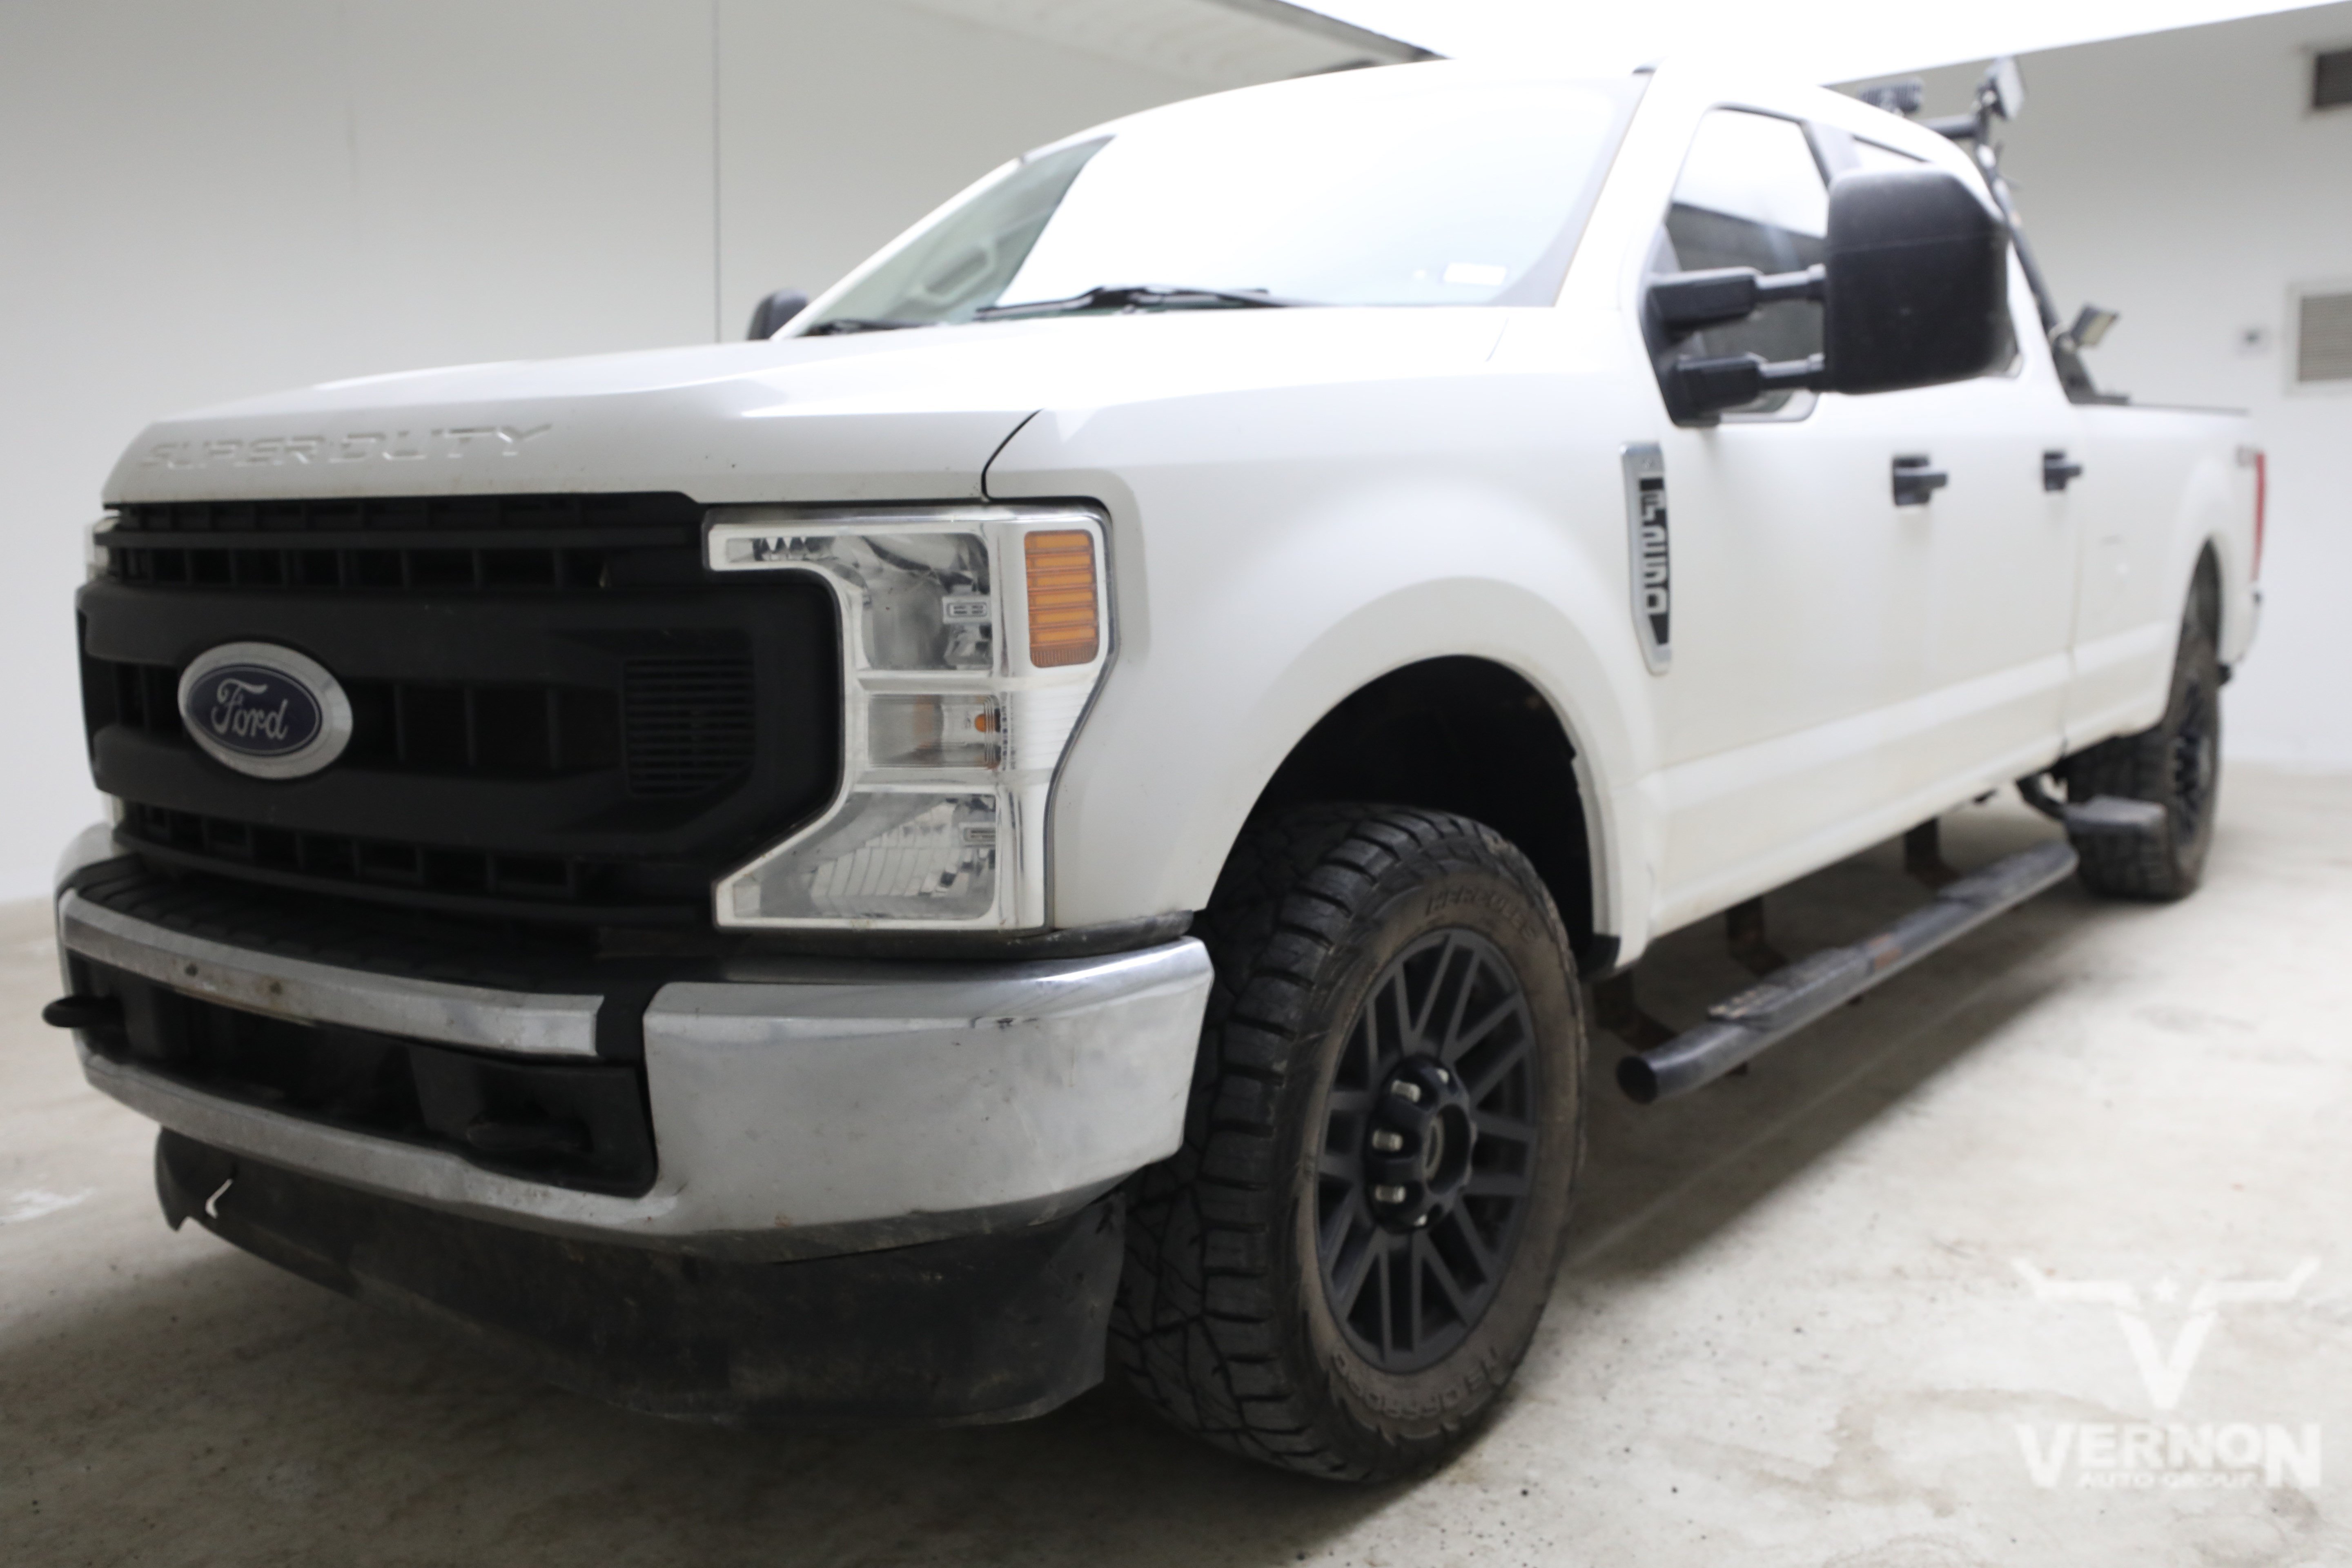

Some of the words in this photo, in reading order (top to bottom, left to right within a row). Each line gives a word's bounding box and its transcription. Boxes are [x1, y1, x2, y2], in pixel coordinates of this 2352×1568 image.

[136, 435, 326, 468] SUPER
[329, 423, 552, 463] DUTY
[211, 678, 287, 739] Ford
